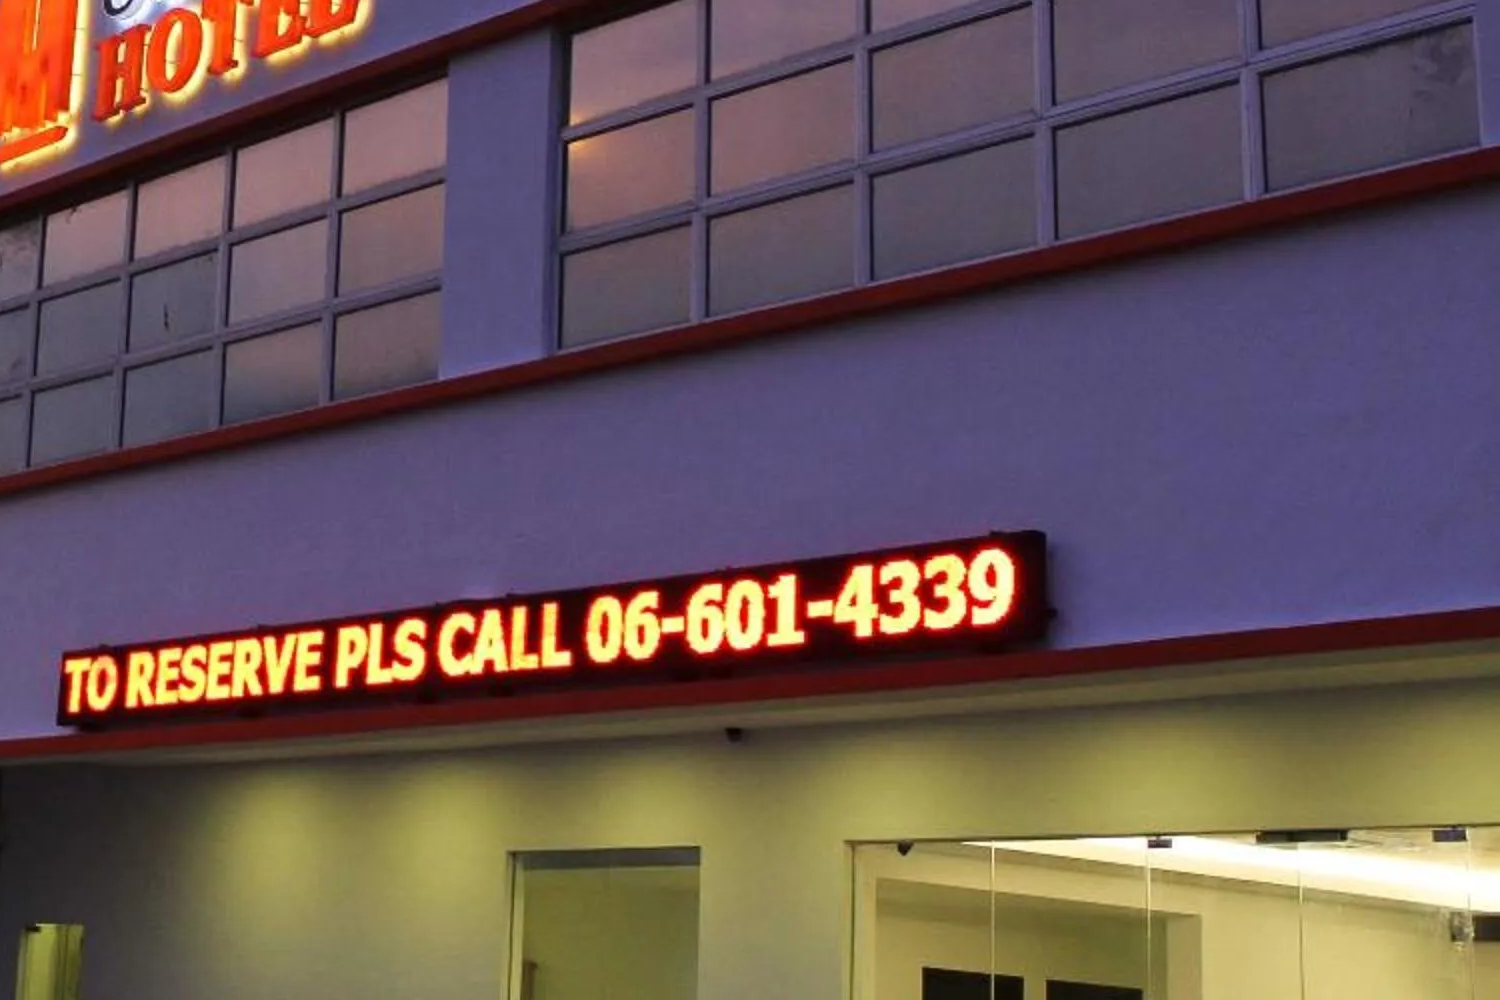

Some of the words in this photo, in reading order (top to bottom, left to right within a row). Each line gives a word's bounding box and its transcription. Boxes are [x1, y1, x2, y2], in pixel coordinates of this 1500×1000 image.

[64, 655, 118, 713] TO
[125, 630, 325, 709] RESERVE
[335, 618, 427, 688] PLS
[437, 602, 572, 677] CALL
[586, 548, 1016, 664] 06-601-4339
